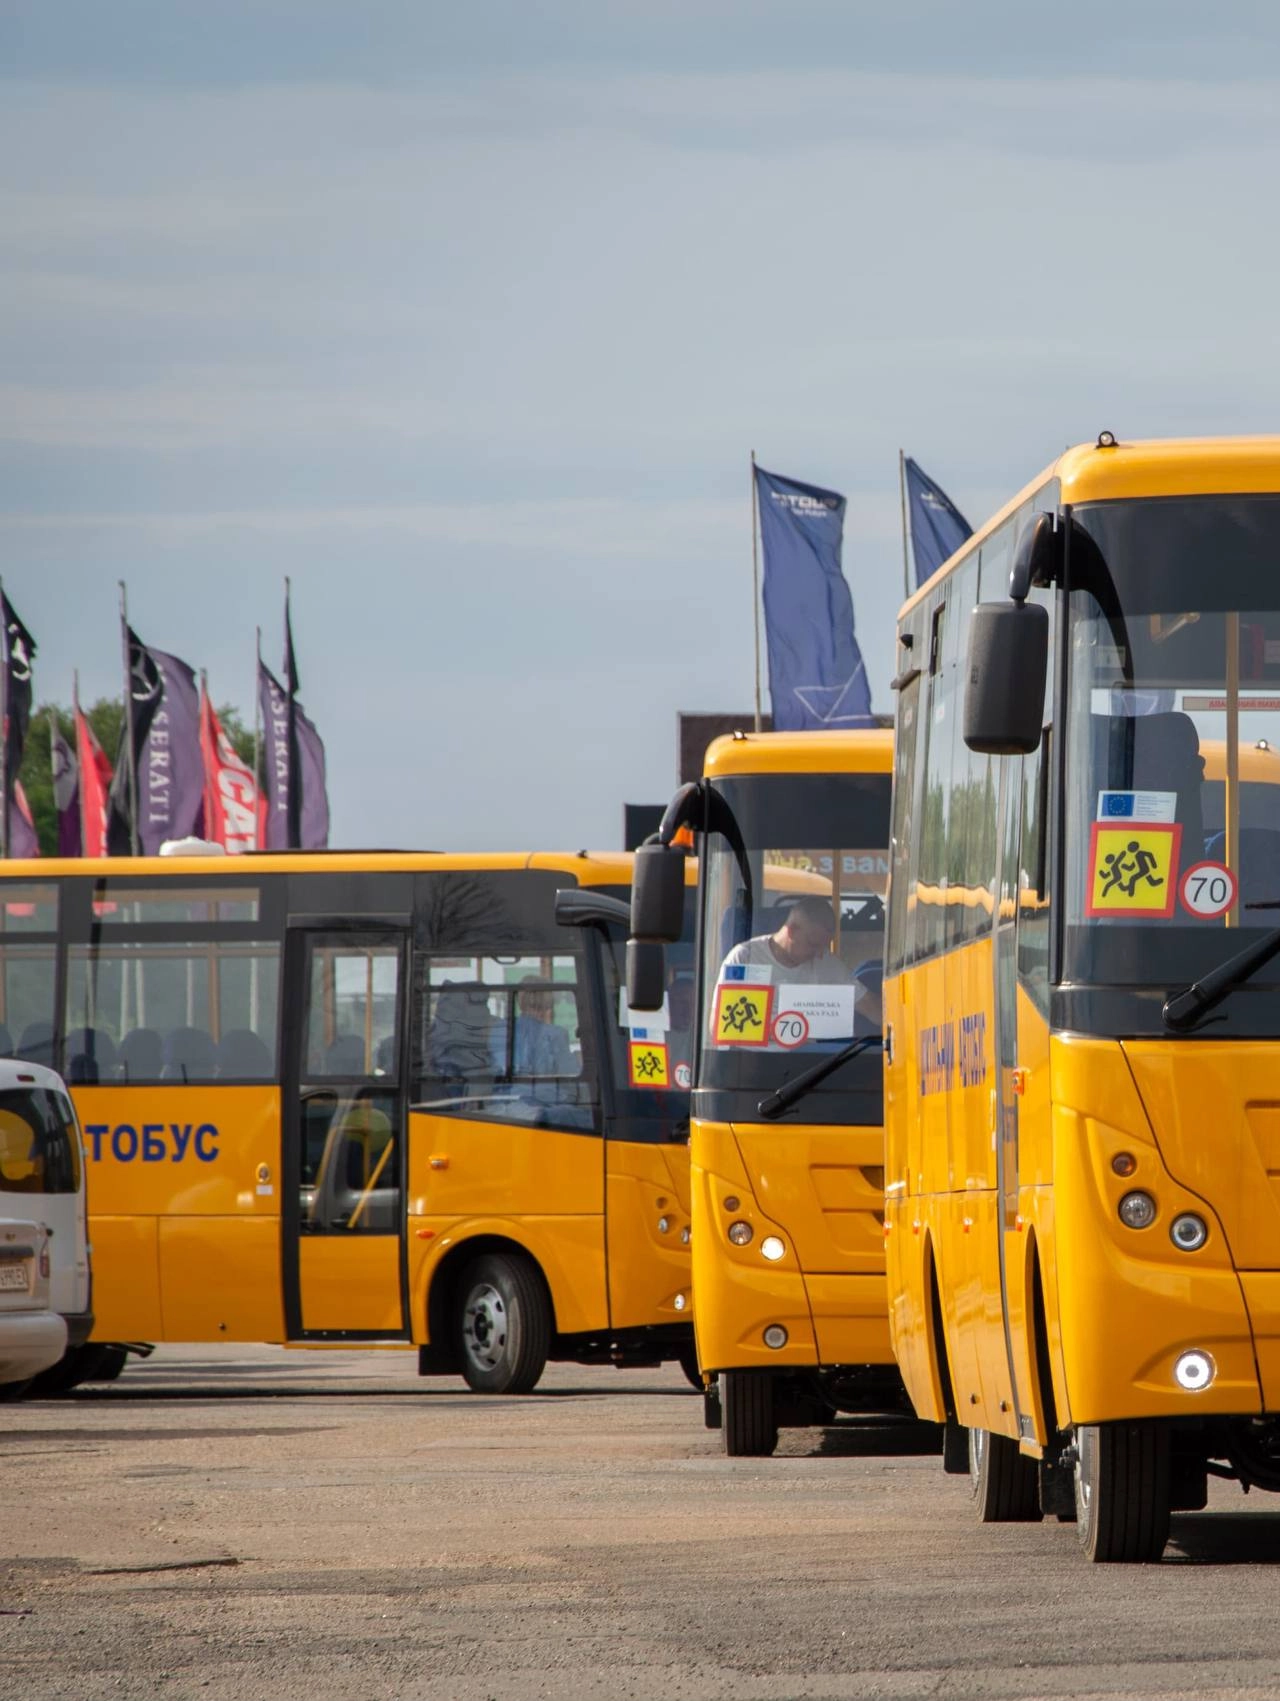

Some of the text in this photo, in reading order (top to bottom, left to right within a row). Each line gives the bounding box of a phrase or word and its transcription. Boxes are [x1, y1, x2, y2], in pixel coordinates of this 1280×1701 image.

[1190, 878, 1227, 904] 70
[779, 1021, 802, 1038] 70
[85, 1124, 220, 1162] ТОБУС
